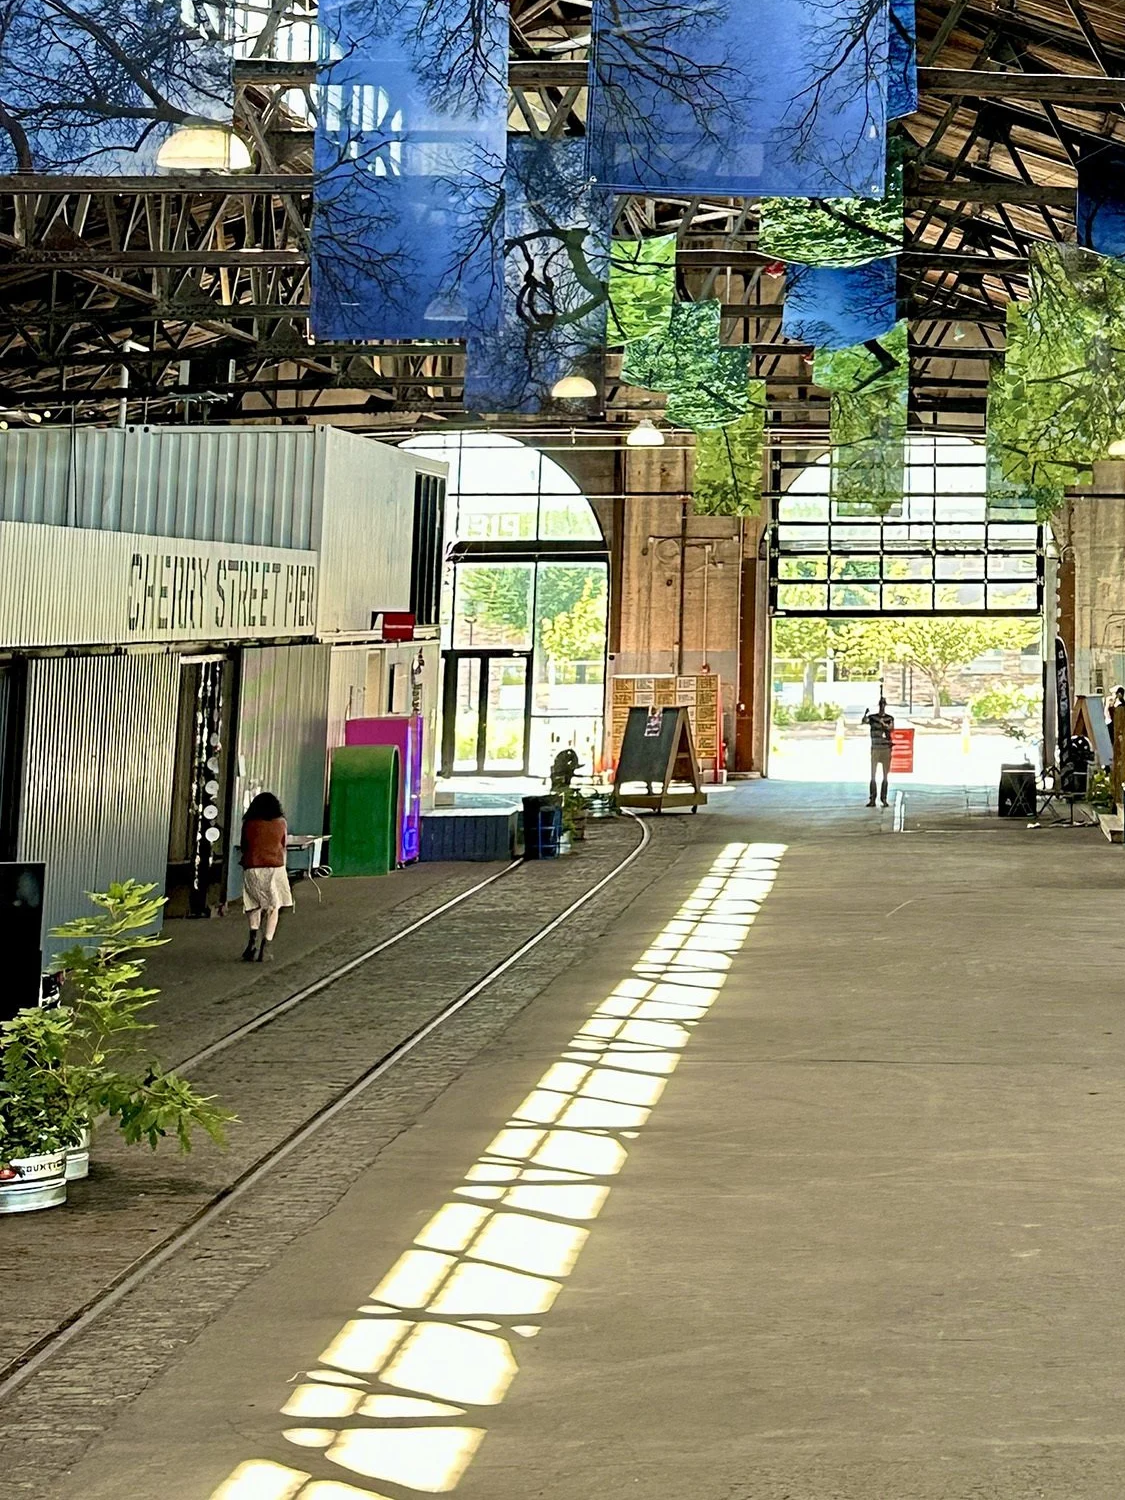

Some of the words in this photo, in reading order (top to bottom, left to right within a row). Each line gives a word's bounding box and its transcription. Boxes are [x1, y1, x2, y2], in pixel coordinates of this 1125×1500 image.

[129, 553, 209, 631] CHERRY
[215, 559, 281, 628] STREET
[284, 564, 315, 627] PIER
